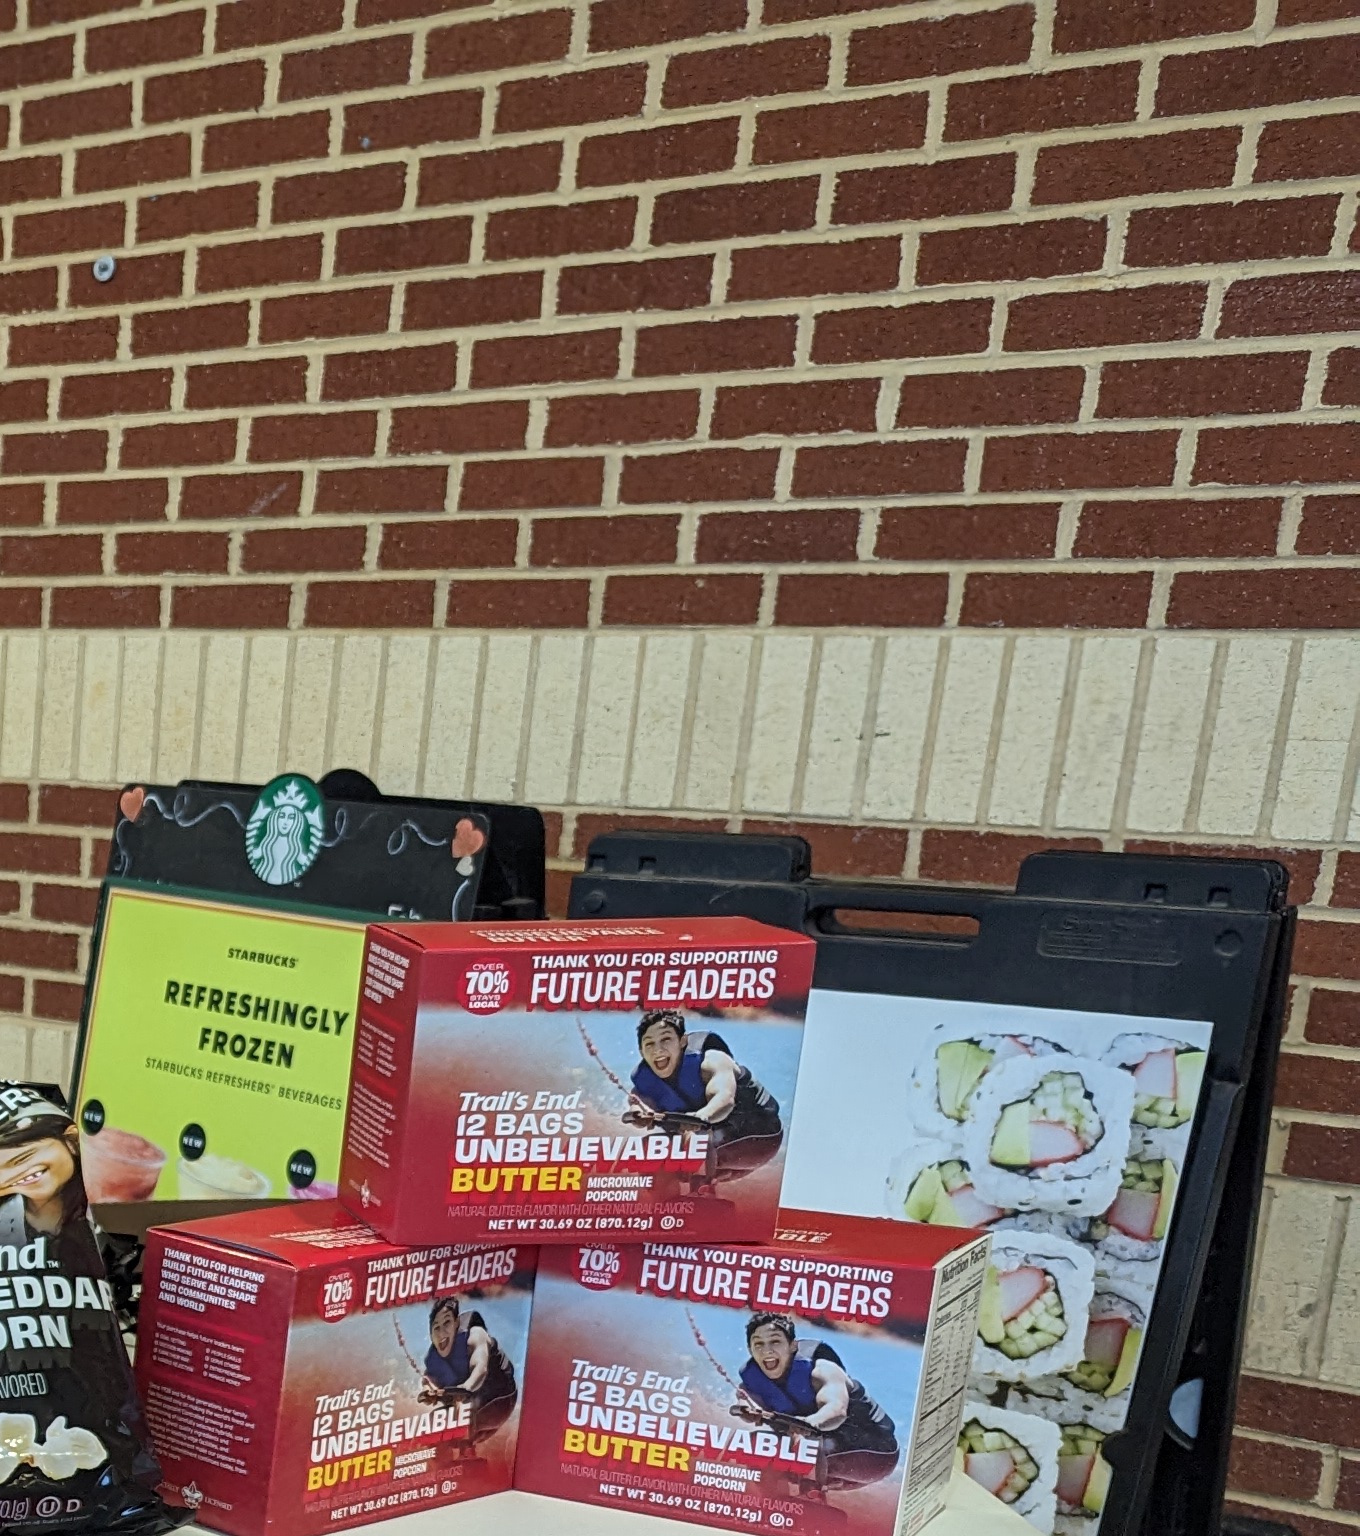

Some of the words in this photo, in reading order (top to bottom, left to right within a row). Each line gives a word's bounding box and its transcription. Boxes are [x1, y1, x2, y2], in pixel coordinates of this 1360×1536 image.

[227, 948, 297, 968] STARBUCKS
[532, 954, 590, 969] THANK
[594, 954, 628, 968] YOU
[632, 953, 665, 967] FOR
[668, 950, 779, 966] SUPPORTING
[465, 970, 509, 995] 70%
[530, 970, 642, 1004] FUTURE
[647, 967, 777, 1001] LEADERS
[164, 980, 349, 1036] REFRESHINGLY
[198, 1027, 295, 1069] FROZEN
[145, 1057, 204, 1080] STARBUCKS
[205, 1070, 271, 1095] REFRESHERS
[278, 1086, 342, 1110] BEVERAGES
[459, 1091, 529, 1112] Trail's
[531, 1087, 580, 1111] End
[83, 1110, 104, 1124] NEW
[457, 1114, 486, 1136] 12
[494, 1112, 584, 1136] BAGS
[182, 1136, 202, 1149] NEW
[454, 1134, 709, 1163] UNBELIEVABLE
[290, 1163, 312, 1176] NEW
[451, 1166, 582, 1193] BUTTER
[587, 1176, 653, 1189] MICROWAVE
[585, 1190, 638, 1202] POPCORN
[488, 1219, 514, 1230] NET
[516, 1219, 537, 1230] WT
[539, 1218, 573, 1229] 30.69
[576, 1218, 592, 1229] OZ
[595, 1216, 653, 1230] (870.12g)
[640, 1259, 752, 1301] FUTURE
[756, 1272, 892, 1318] LEADERS
